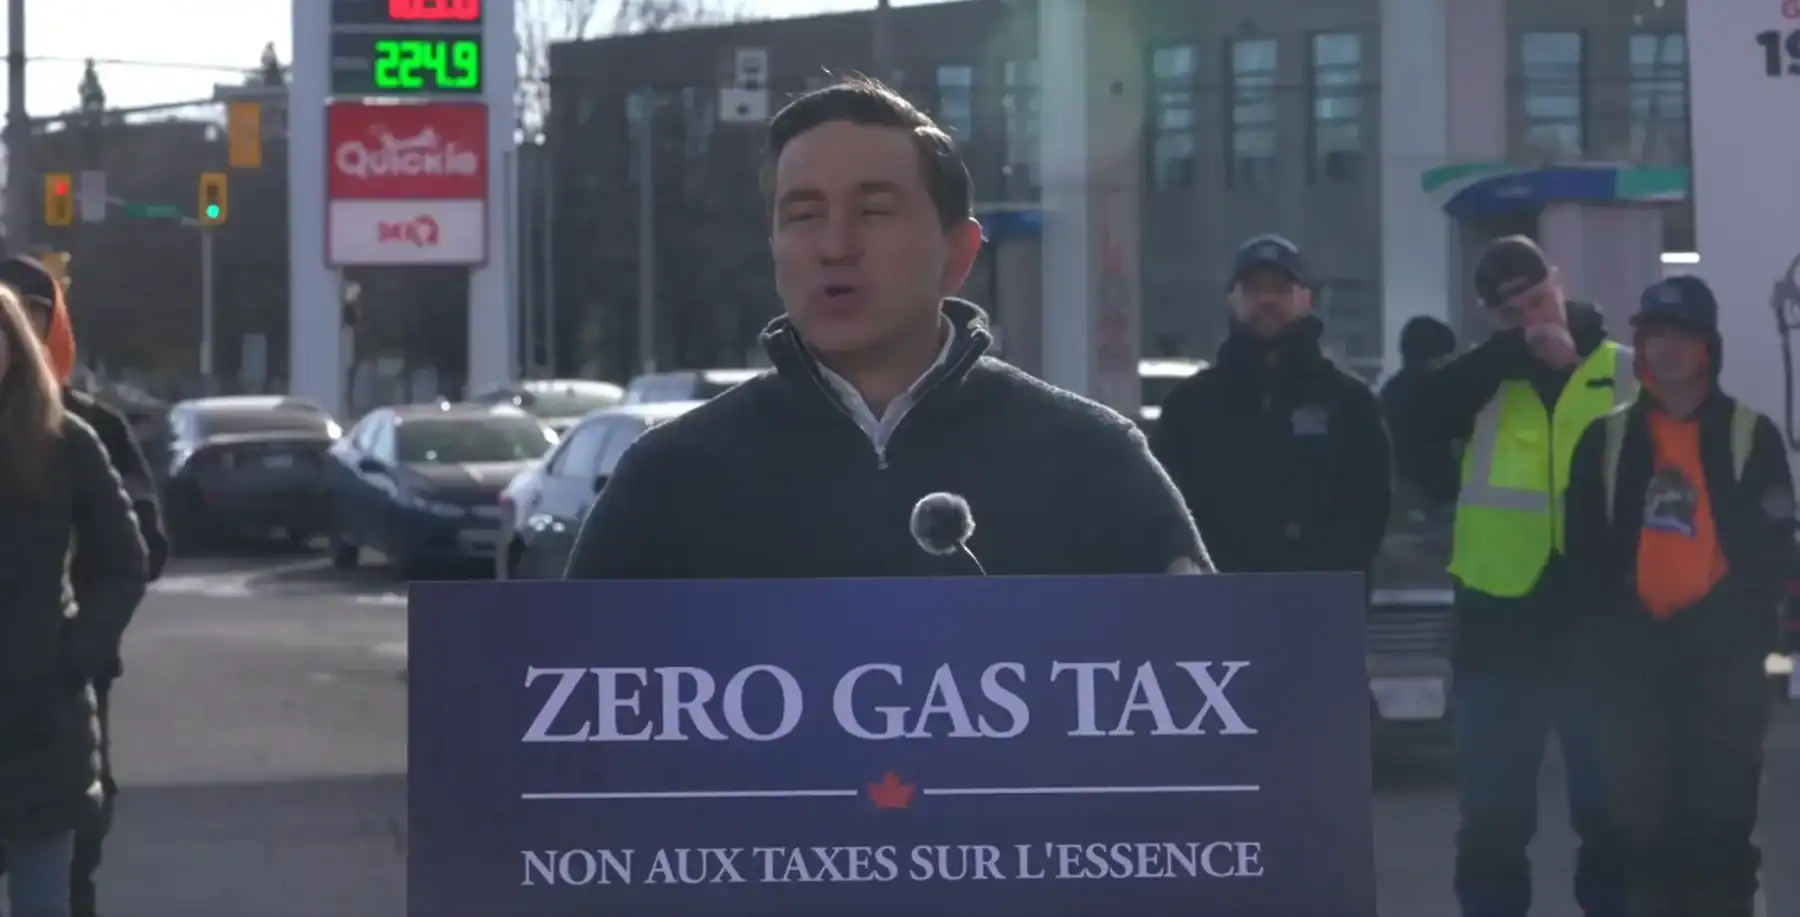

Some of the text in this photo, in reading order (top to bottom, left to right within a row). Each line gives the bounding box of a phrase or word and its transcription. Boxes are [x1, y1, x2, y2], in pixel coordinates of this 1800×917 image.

[375, 40, 478, 88] 224.9
[521, 659, 1258, 742] ZERO GAS TAX
[521, 841, 1264, 886] NON AUX TAXES SUR L'ESSENCE
